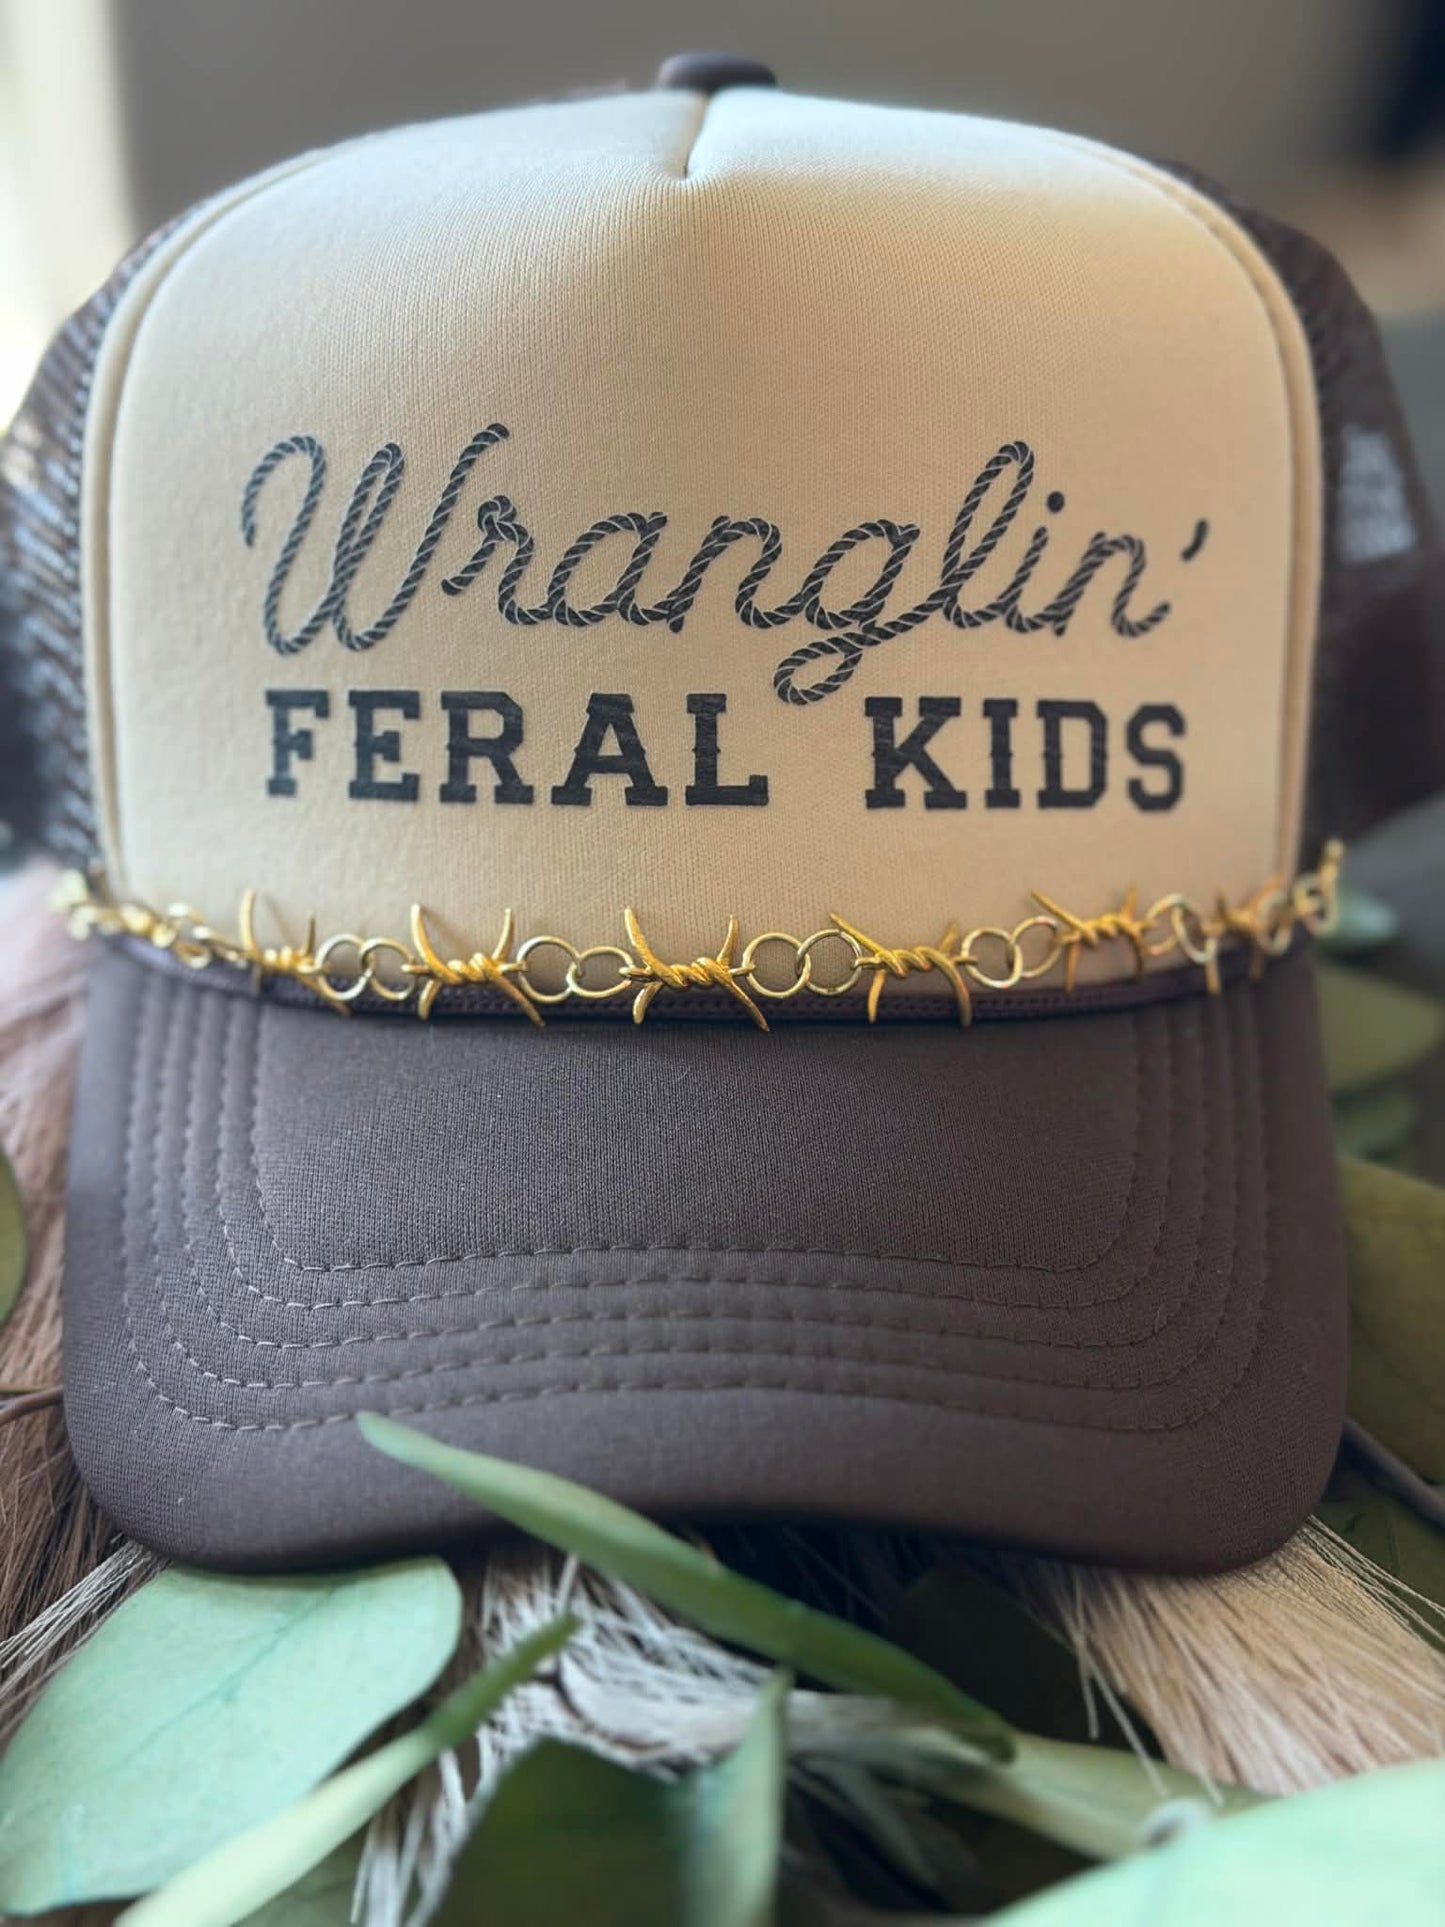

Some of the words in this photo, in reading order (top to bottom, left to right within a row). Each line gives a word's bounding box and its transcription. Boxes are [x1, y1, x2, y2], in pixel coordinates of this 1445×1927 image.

[241, 422, 1211, 706] Wranglin'
[265, 689, 770, 808] FERAL
[864, 696, 1186, 813] KIDS
